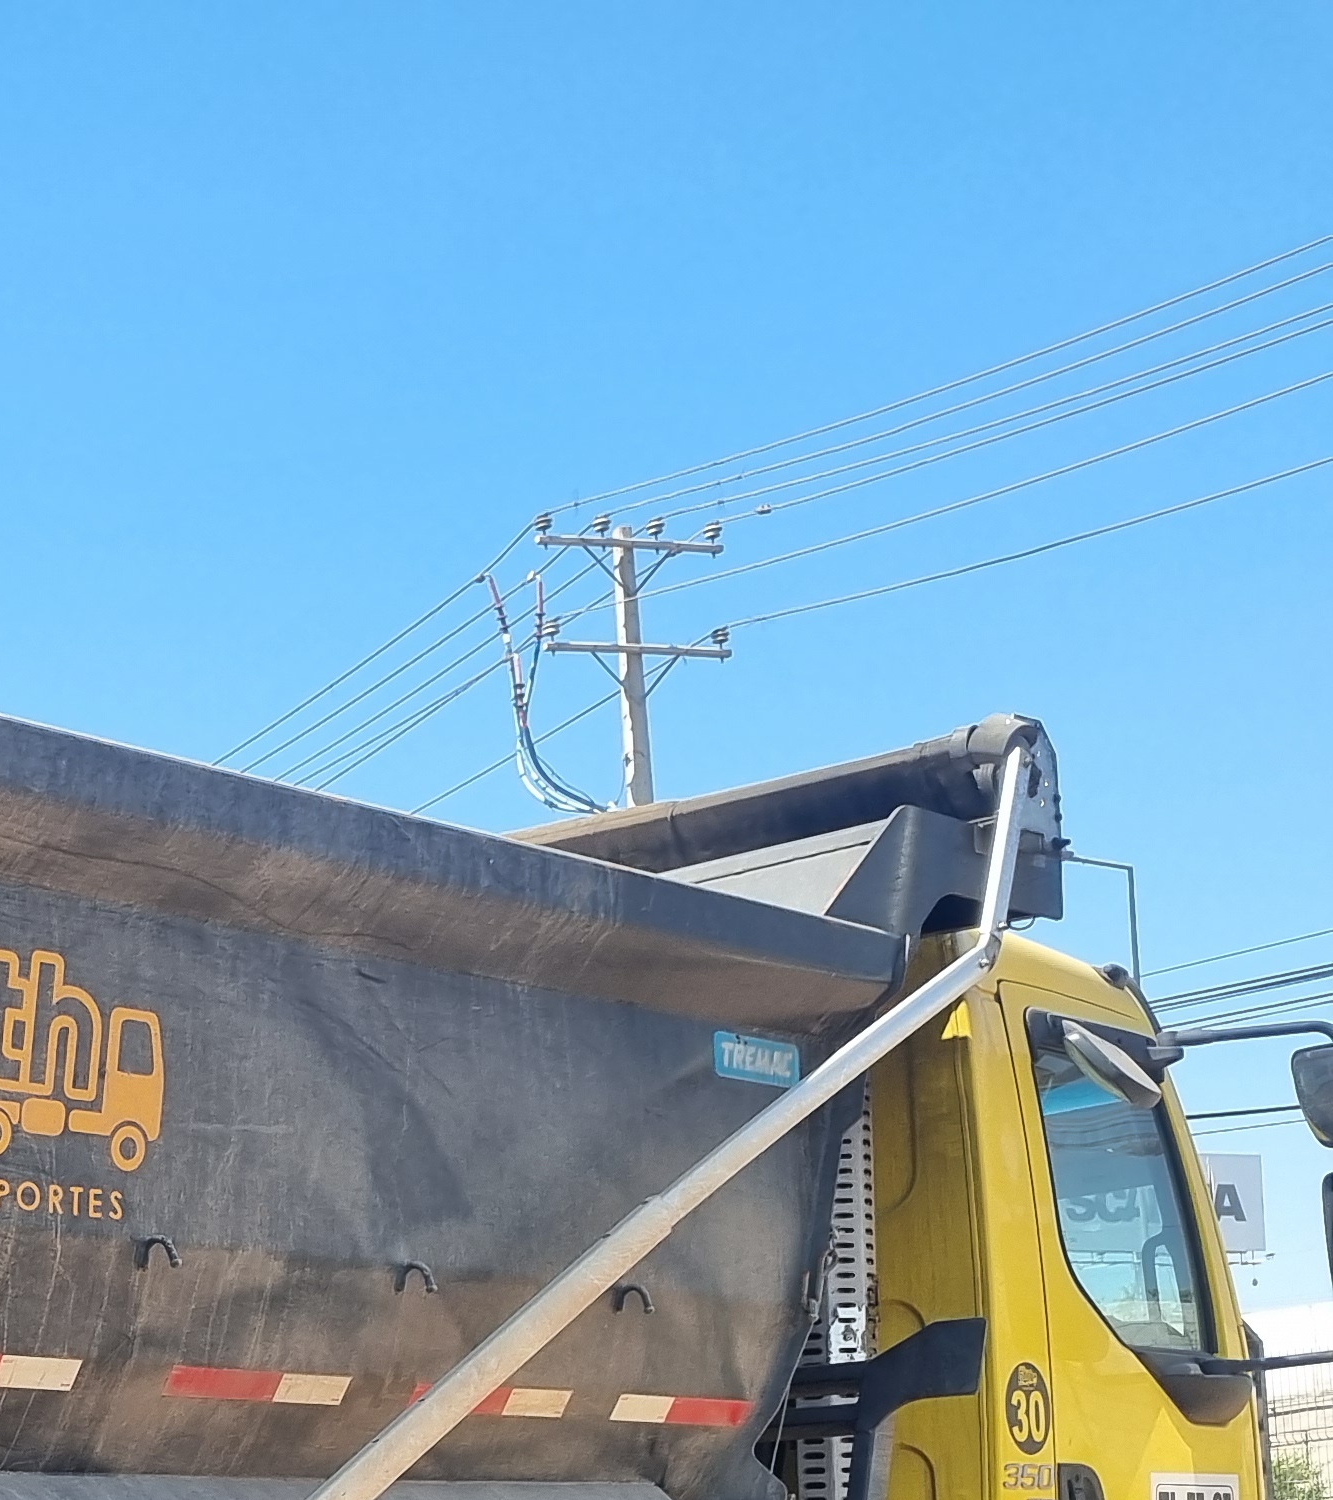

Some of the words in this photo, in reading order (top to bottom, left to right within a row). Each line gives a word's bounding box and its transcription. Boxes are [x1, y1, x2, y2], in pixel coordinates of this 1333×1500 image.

[721, 1041, 793, 1078] TREMAC
[1010, 1389, 1046, 1444] 30
[1003, 1463, 1054, 1490] 350
